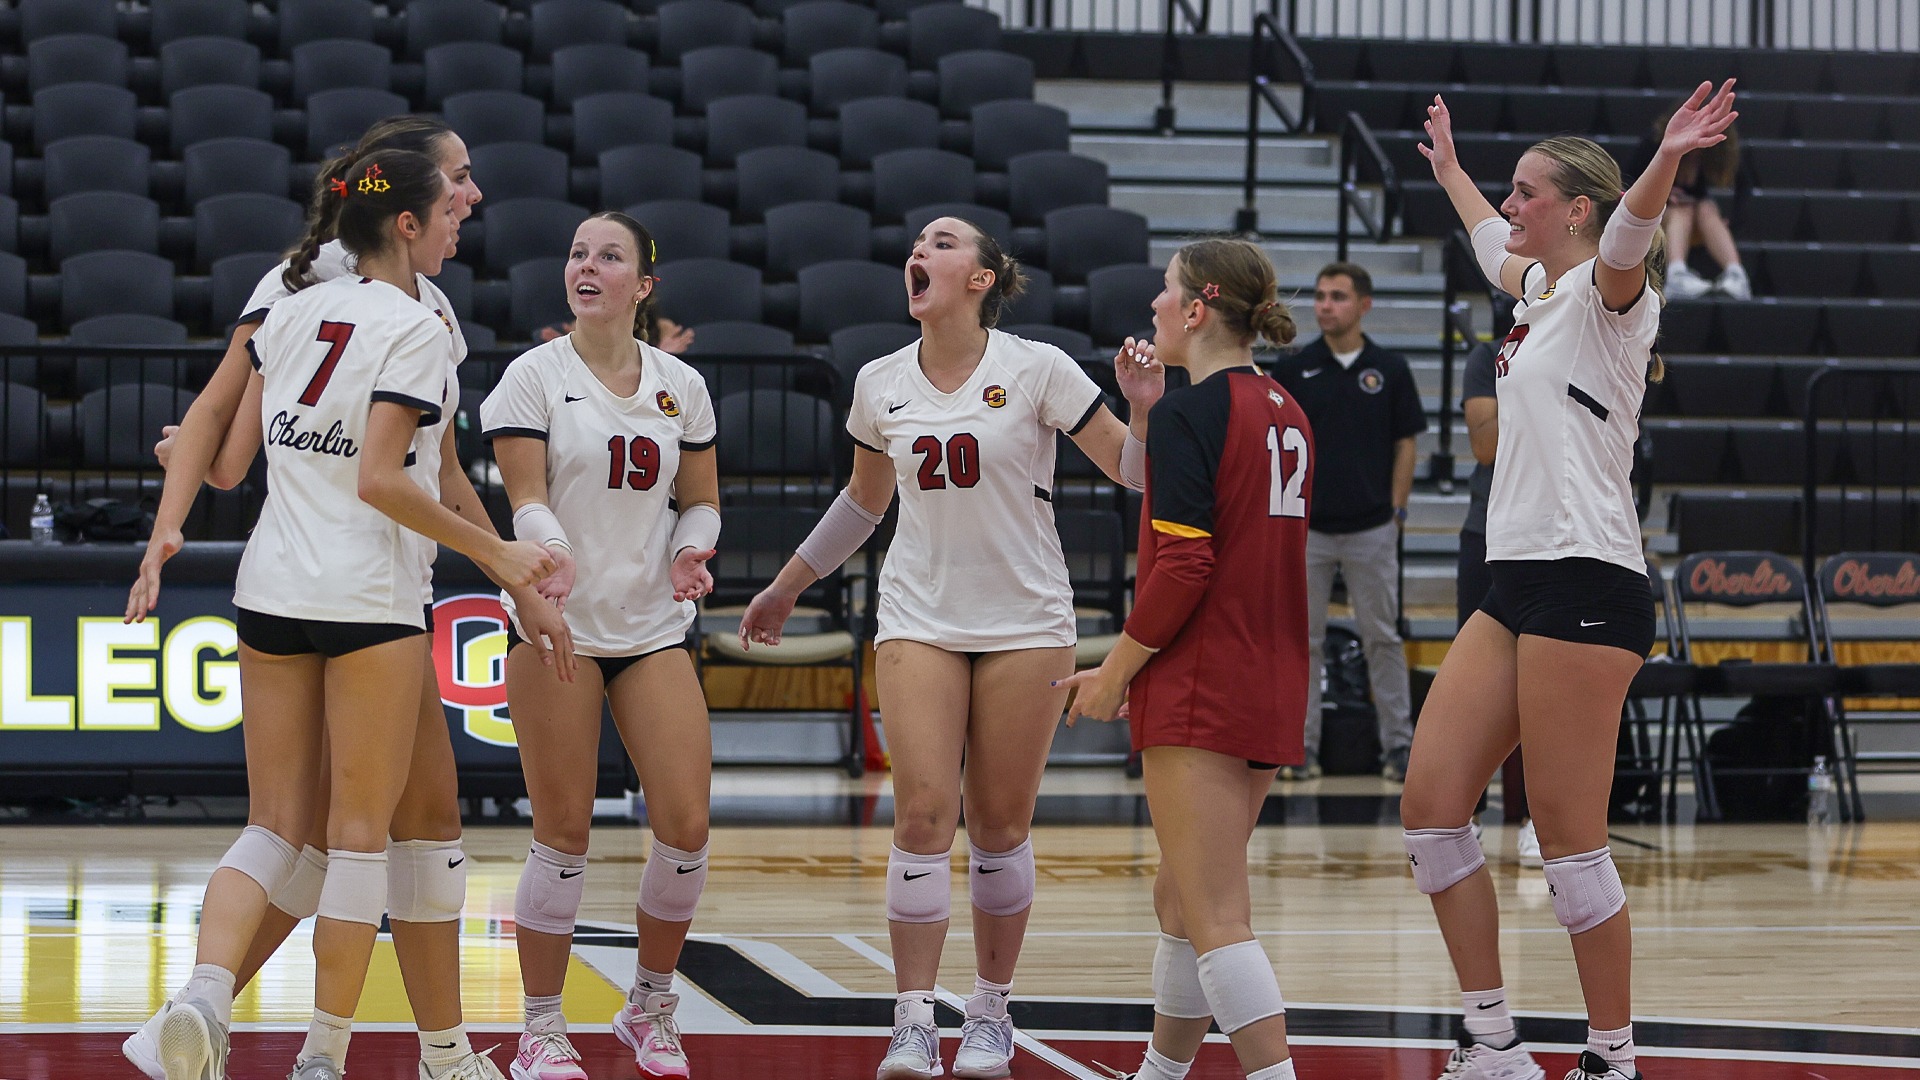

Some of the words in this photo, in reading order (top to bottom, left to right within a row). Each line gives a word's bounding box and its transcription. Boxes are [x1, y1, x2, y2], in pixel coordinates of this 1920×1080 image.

[297, 320, 356, 407] 7
[269, 410, 358, 458] Oberlin
[608, 434, 661, 491] 19
[912, 433, 981, 490] 20
[1266, 424, 1308, 518] 12
[1690, 558, 1792, 595] Oberlin
